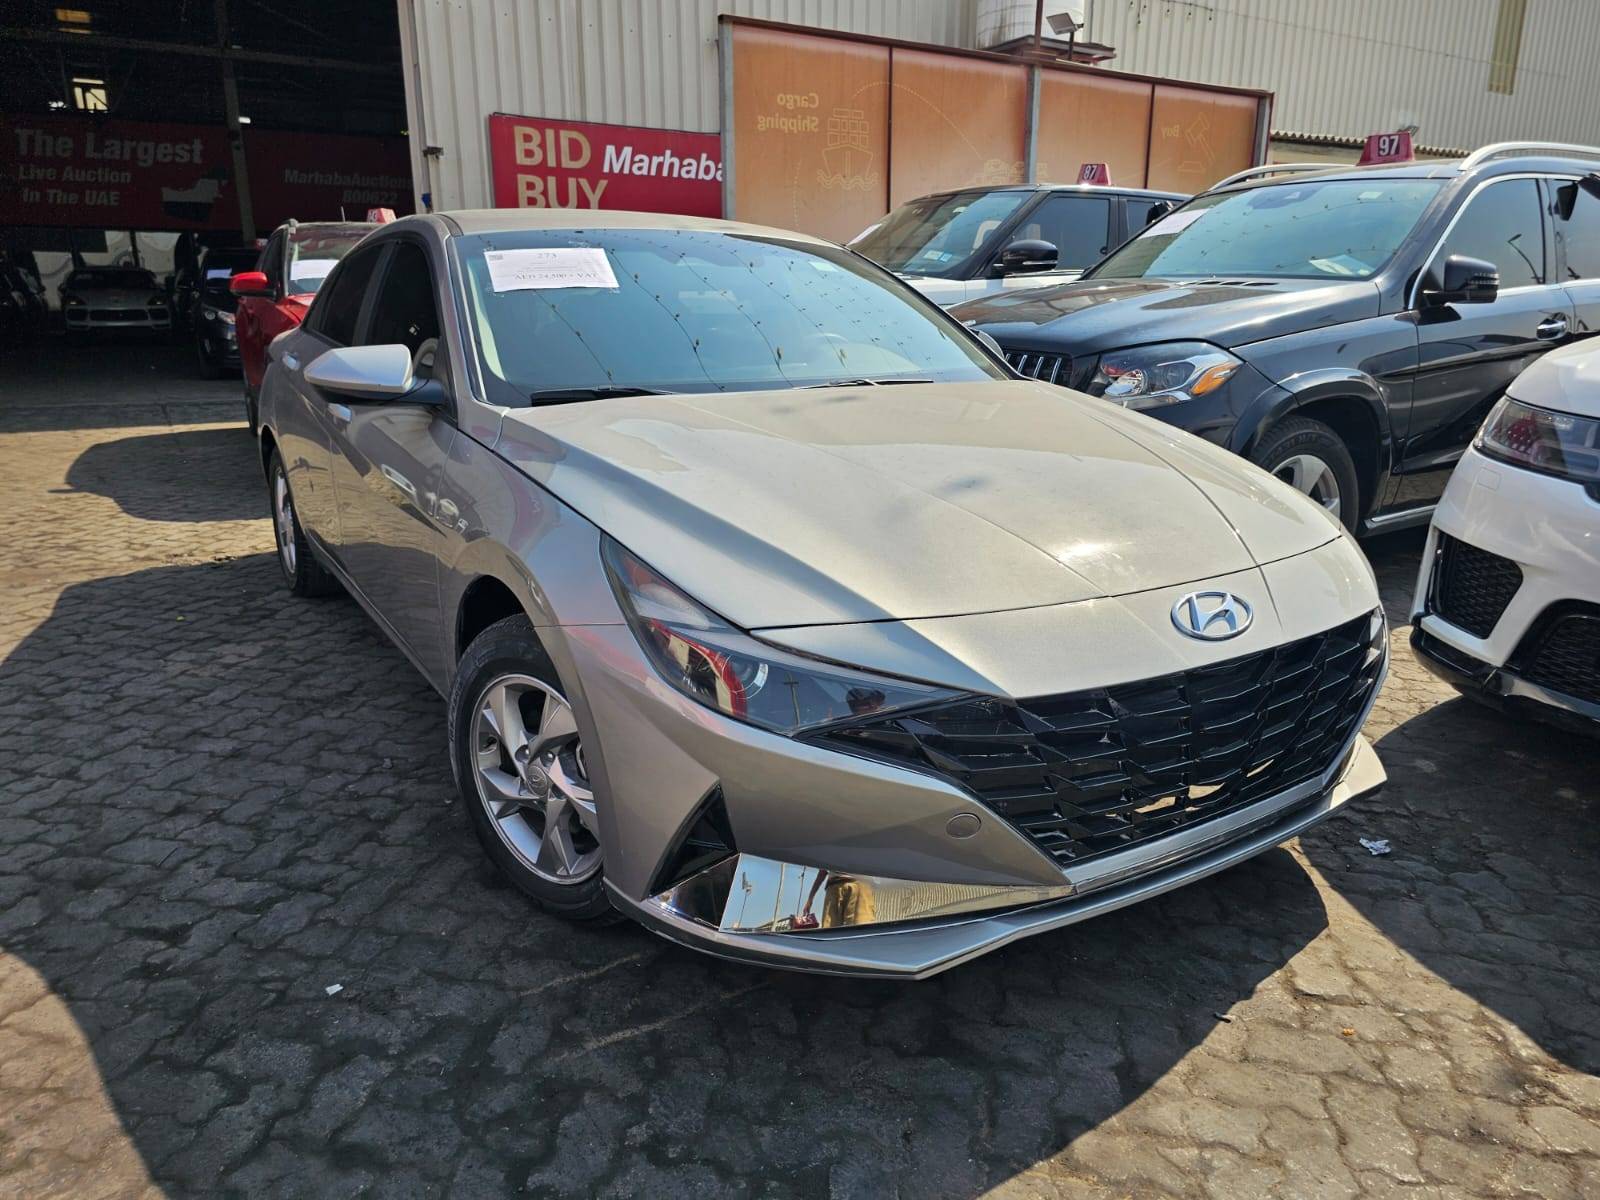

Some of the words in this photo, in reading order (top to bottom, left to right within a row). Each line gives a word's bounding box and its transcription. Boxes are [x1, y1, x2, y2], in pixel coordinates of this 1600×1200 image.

[15, 129, 74, 158] The
[85, 131, 204, 167] Largest
[513, 125, 592, 169] BID
[1379, 135, 1399, 156] 97
[19, 166, 57, 181] Live
[62, 167, 131, 184] Auction
[23, 188, 41, 203] In
[46, 189, 79, 204] The
[85, 190, 120, 206] UAE
[517, 173, 608, 210] BUY
